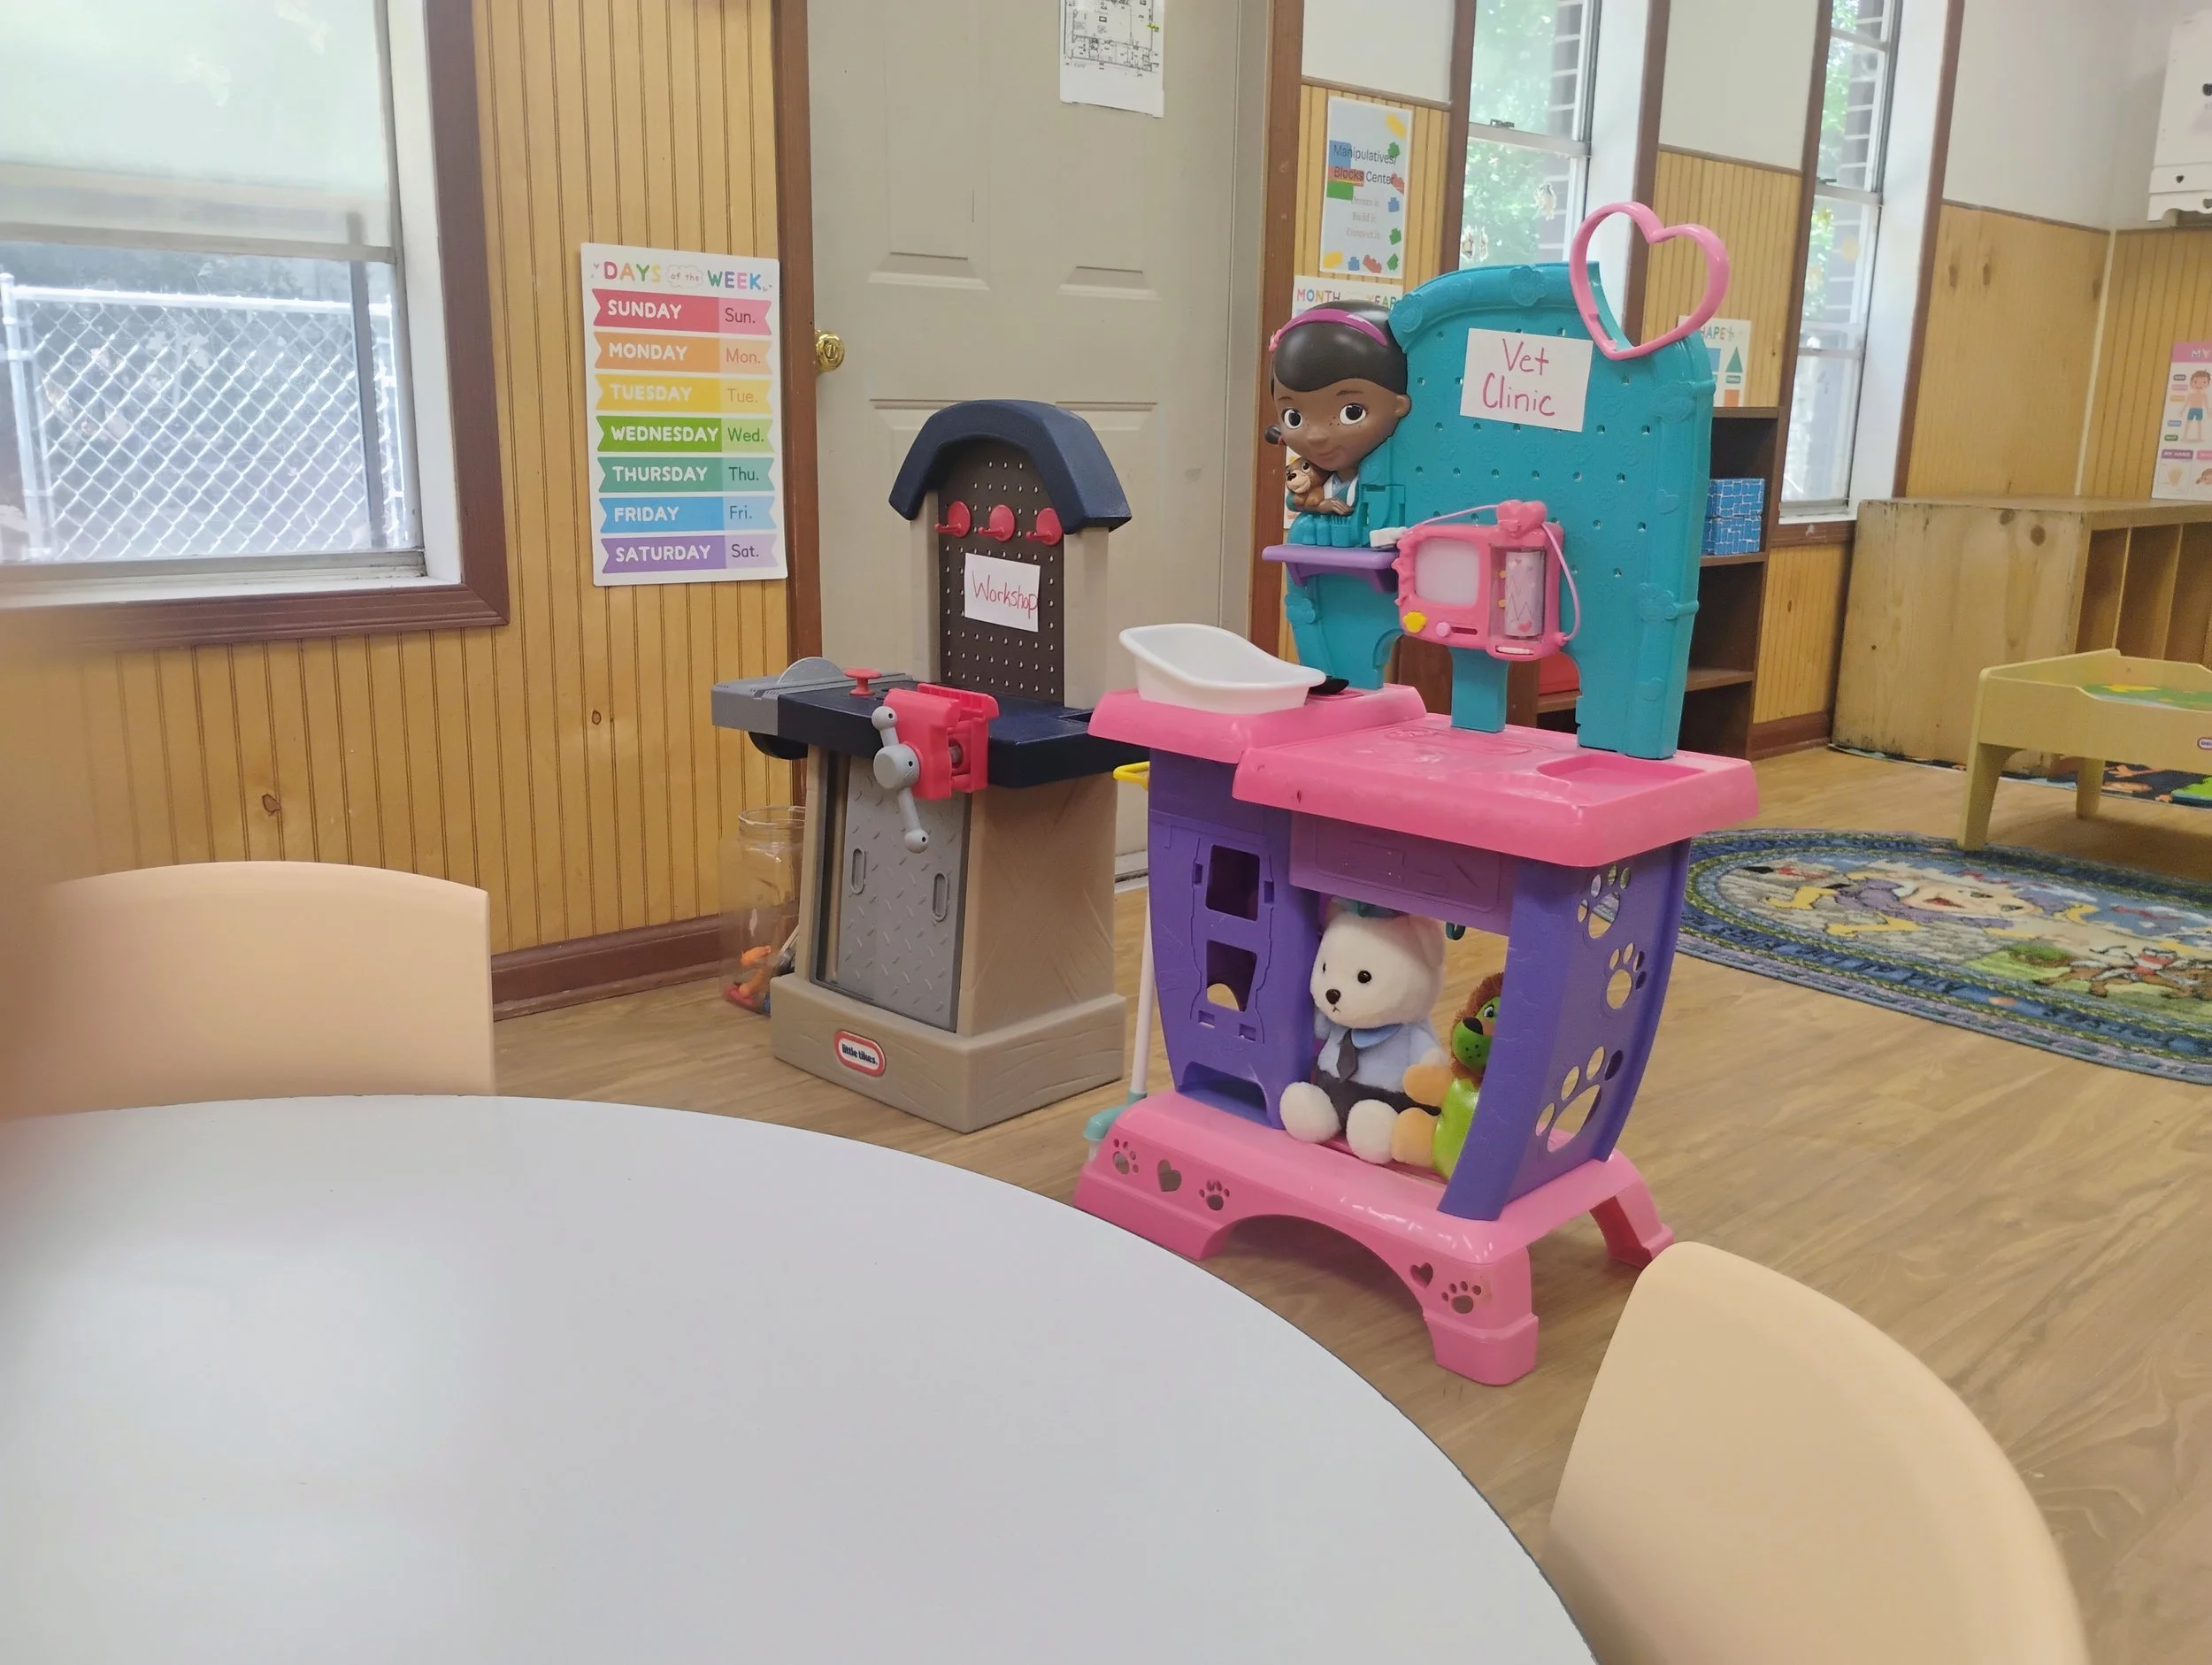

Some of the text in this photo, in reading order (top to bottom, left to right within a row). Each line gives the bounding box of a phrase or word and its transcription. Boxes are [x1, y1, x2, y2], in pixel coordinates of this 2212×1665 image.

[1334, 165, 1364, 181] Blocks
[603, 261, 661, 283] DAYS
[685, 272, 700, 281] the
[707, 269, 762, 291] WEEK
[1296, 288, 1340, 302] MONTH
[608, 299, 756, 324] SUNDAY Sun.
[609, 342, 761, 364] MONDAY Mon.
[1502, 338, 1549, 375] Vet
[610, 383, 757, 403] TUESDAY Tue.
[1482, 372, 1555, 417] Clinic
[611, 426, 764, 442] WEDNESDAY Wed.
[612, 465, 759, 482] THURSDAY Thu.
[614, 505, 752, 522] FRIDAY Fri.
[615, 543, 759, 563] SATURDAY Sat.
[972, 570, 1039, 620] Workshop
[841, 1043, 858, 1058] little
